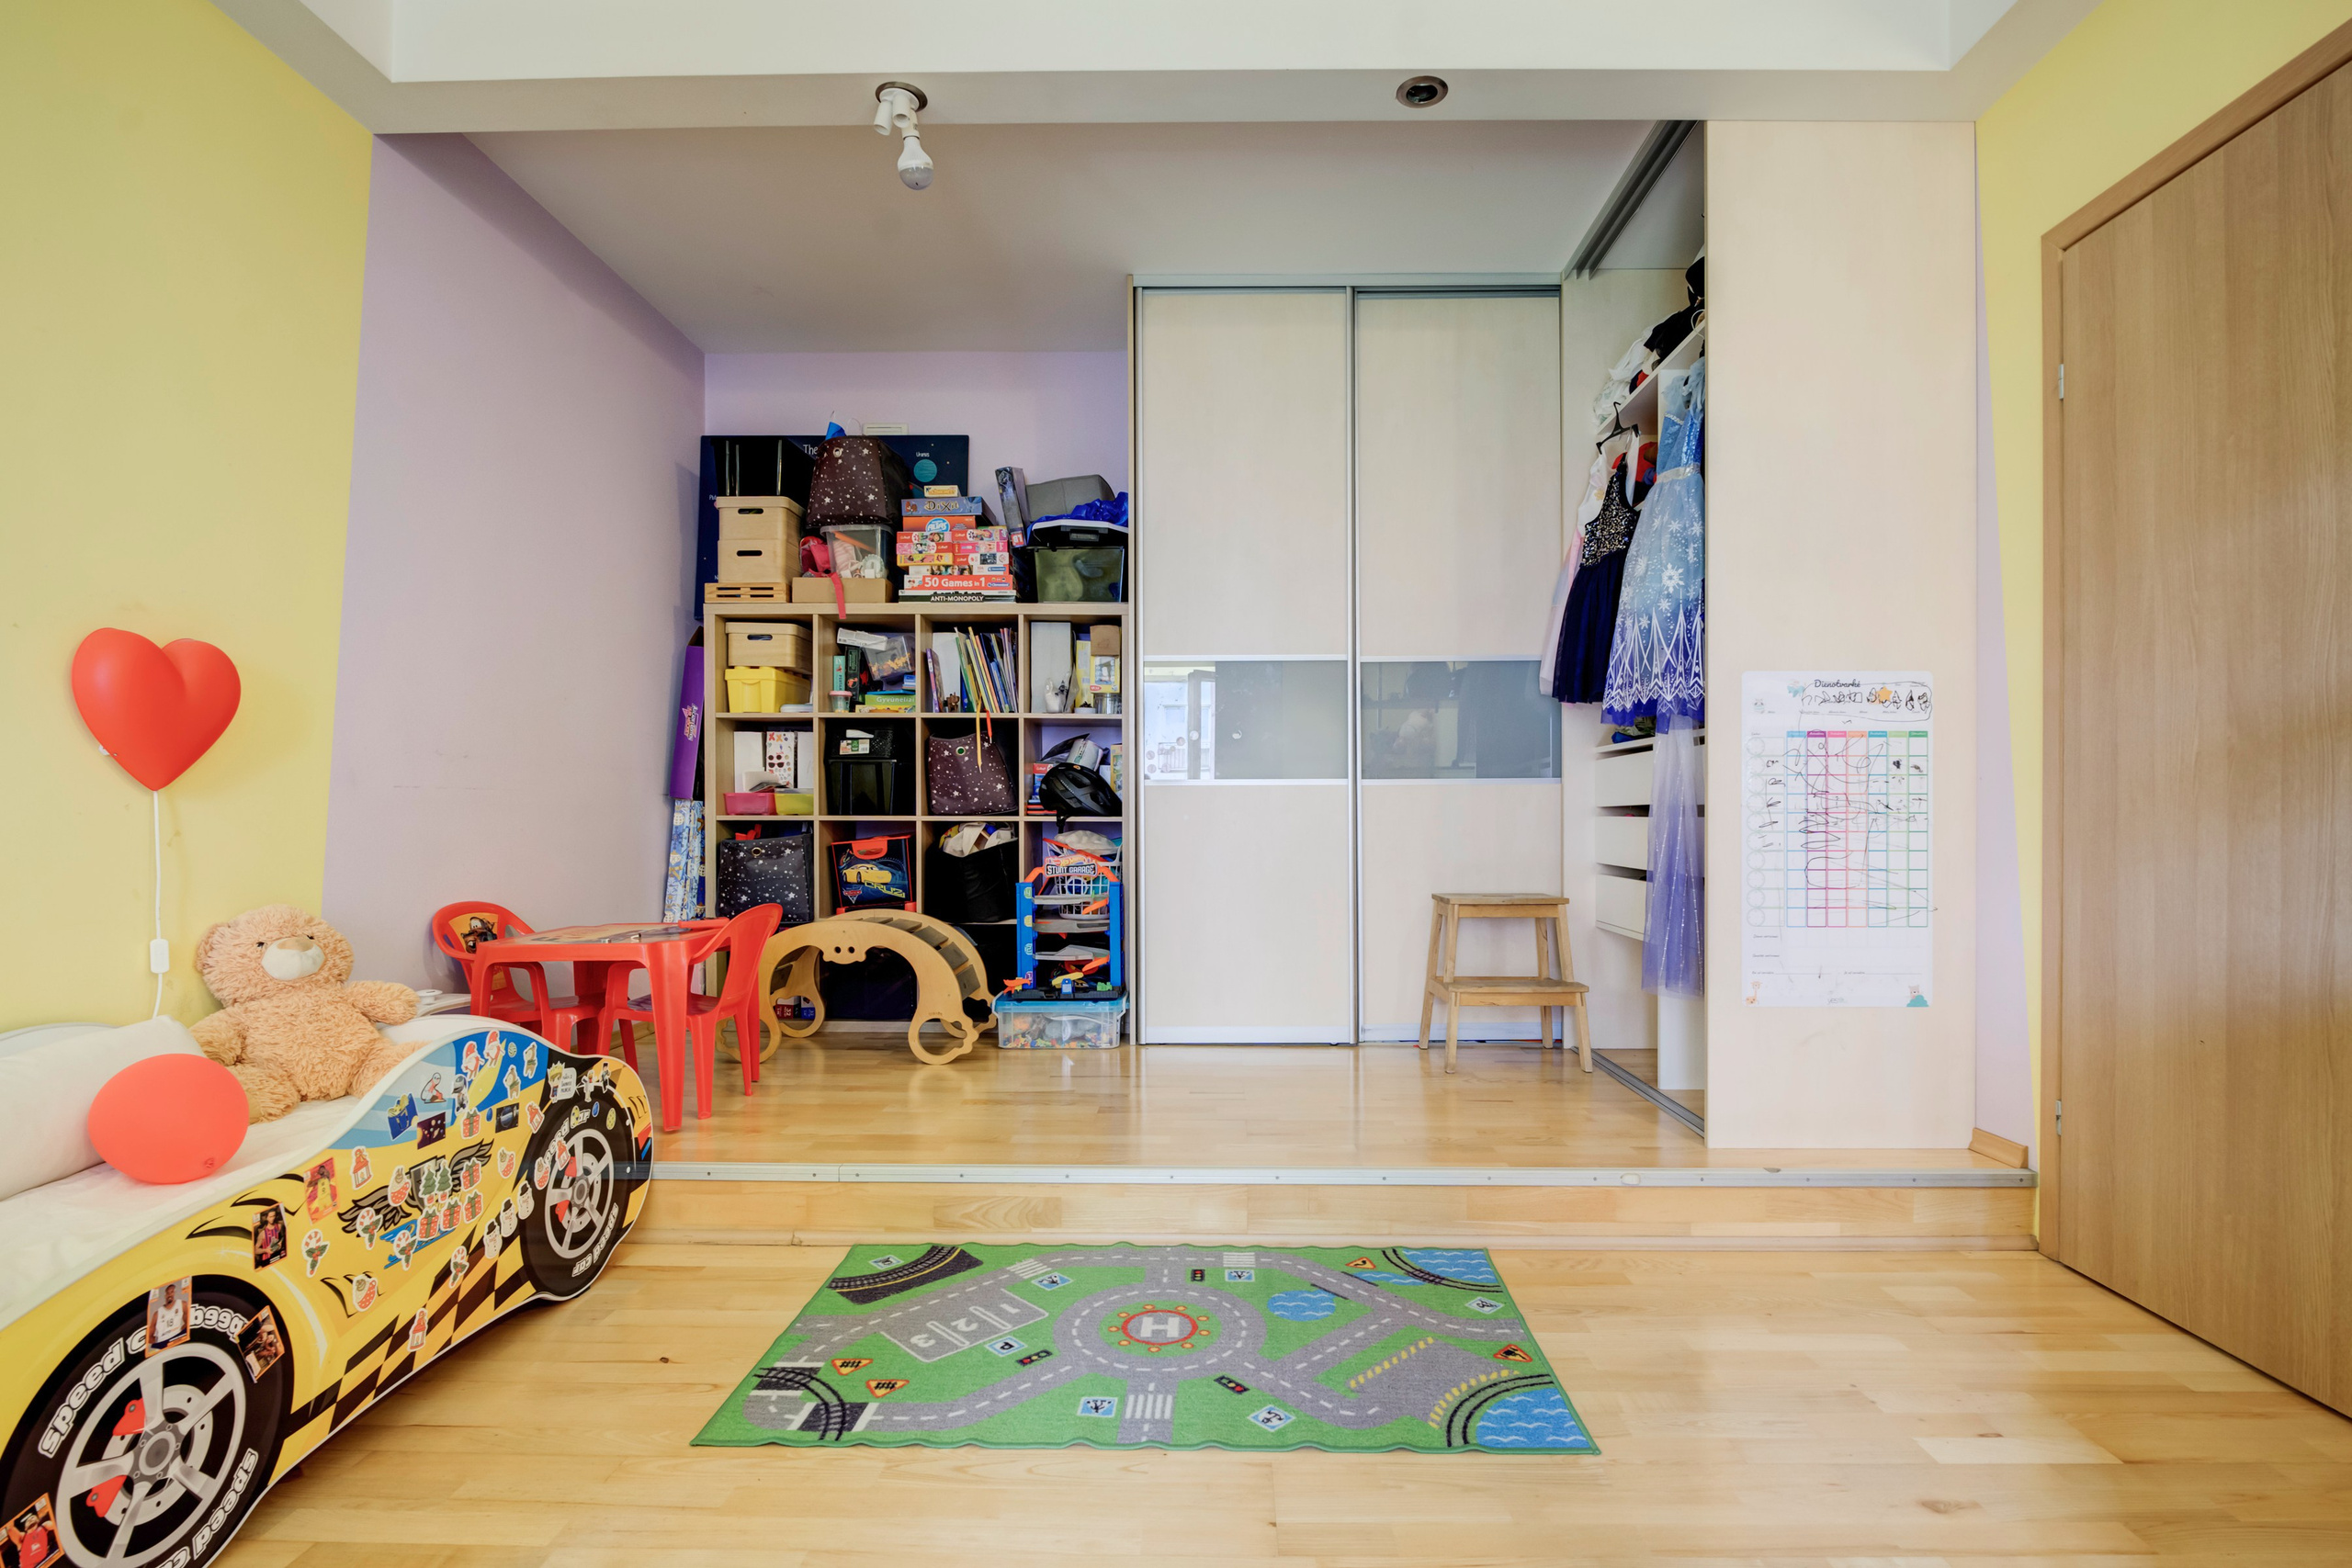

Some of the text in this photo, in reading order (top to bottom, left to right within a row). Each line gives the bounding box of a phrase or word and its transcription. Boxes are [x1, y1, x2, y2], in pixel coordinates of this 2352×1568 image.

[803, 444, 819, 455] The
[924, 577, 939, 587] 50
[941, 577, 972, 587] Games
[979, 577, 985, 587] 1
[1814, 679, 1861, 688] Dienotvarkė
[1047, 864, 1094, 874] STUNT GARAGE
[543, 1117, 570, 1165] peed
[951, 1317, 978, 1332] 2
[1140, 1316, 1180, 1337] H
[910, 1334, 936, 1348] 3
[38, 1337, 126, 1458] speed
[192, 1448, 258, 1560] speed
